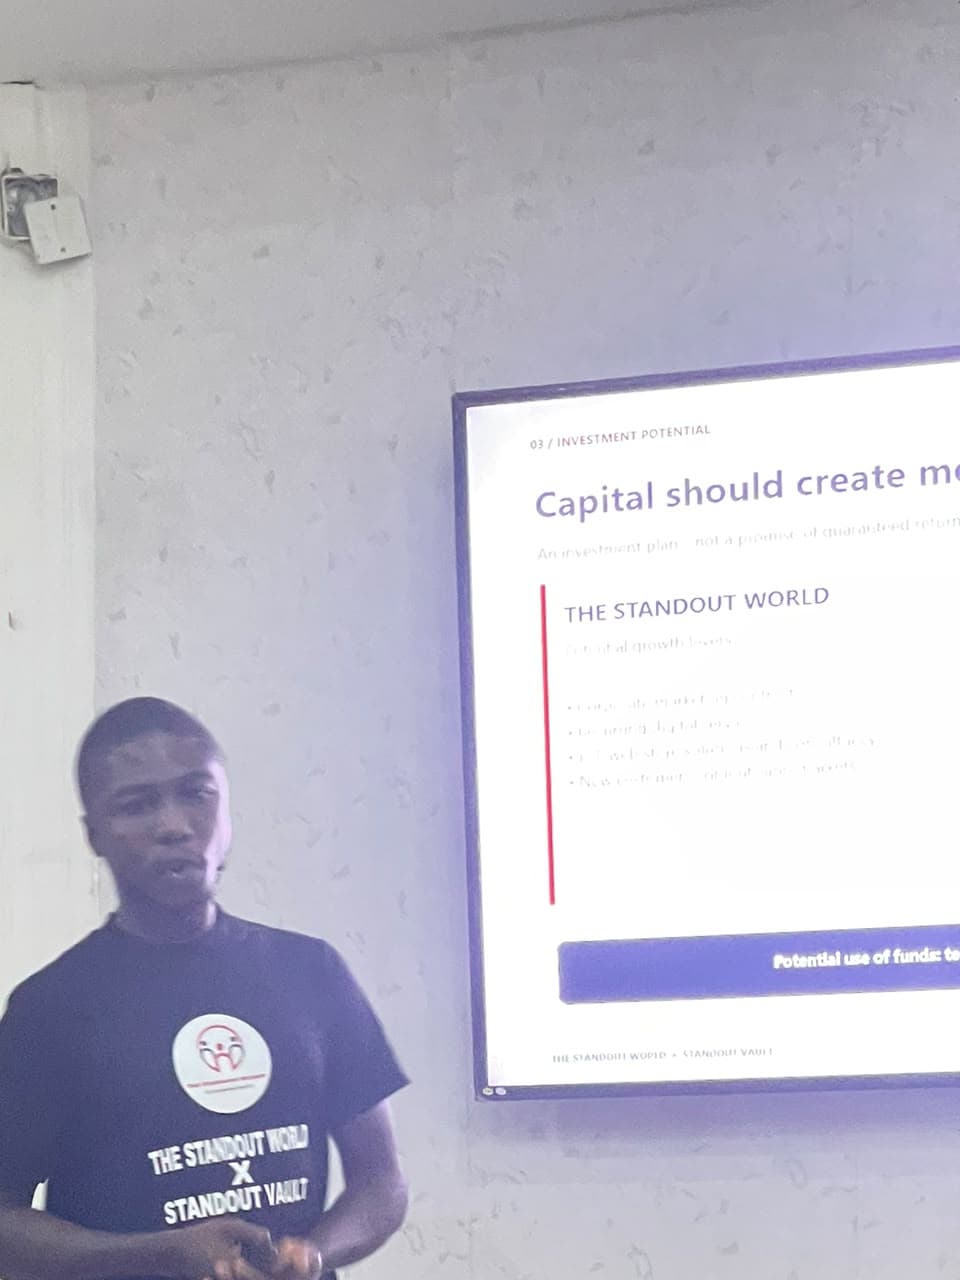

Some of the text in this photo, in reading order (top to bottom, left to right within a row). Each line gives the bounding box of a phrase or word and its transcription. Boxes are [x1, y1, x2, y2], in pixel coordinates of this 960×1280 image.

[530, 440, 544, 450] 03
[556, 431, 637, 448] INVESTMENT
[641, 424, 711, 440] POTENTIAL
[535, 481, 654, 522] Capital
[666, 470, 784, 508] should
[796, 465, 905, 497] create
[564, 586, 830, 624] THE STANDOUT WORLD
[773, 950, 841, 969] Potential
[843, 953, 870, 966] use
[872, 948, 892, 965] of
[892, 946, 942, 964] funds:
[147, 1123, 310, 1176] THE STANDOUT WORLD
[228, 1159, 255, 1187] X
[163, 1177, 310, 1226] STANDOUT VAULT
